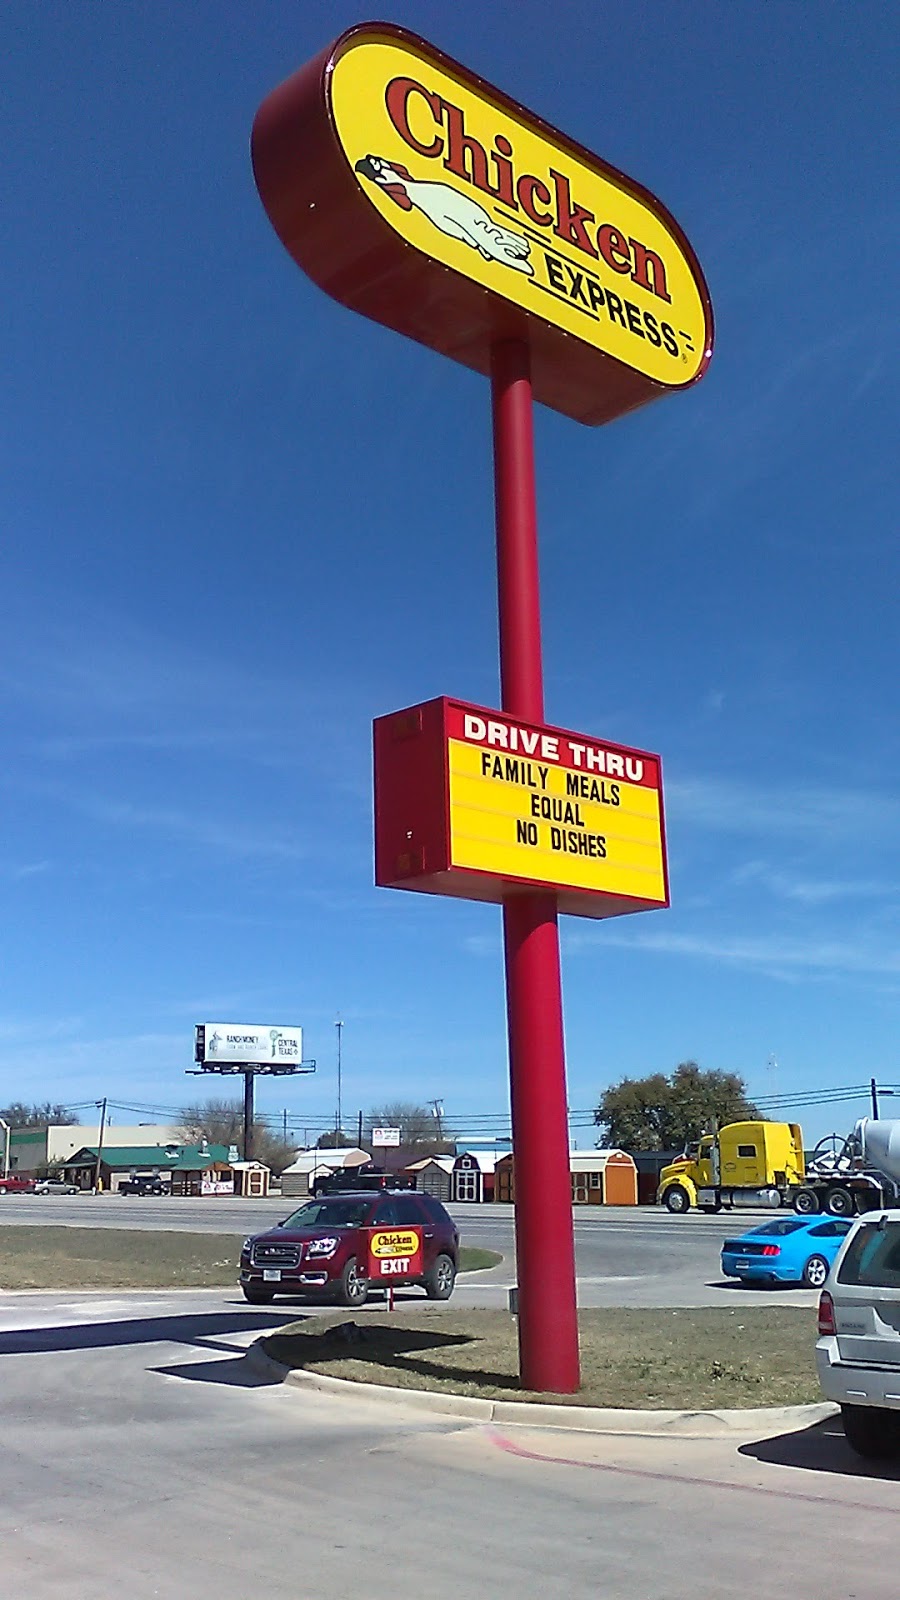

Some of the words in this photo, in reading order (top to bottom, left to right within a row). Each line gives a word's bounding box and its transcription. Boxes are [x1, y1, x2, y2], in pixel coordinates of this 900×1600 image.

[384, 76, 672, 304] Chicken
[545, 253, 679, 357] EXPRESS
[464, 714, 560, 761] DRIVE
[568, 741, 644, 782] THRU
[481, 752, 549, 790] FAMILY
[566, 772, 621, 807] MEALS
[530, 794, 585, 827] EQUAL
[516, 819, 538, 846] NO
[550, 826, 607, 858] DISHES
[378, 1234, 413, 1246] Chicken
[380, 1257, 411, 1275] EXIT
